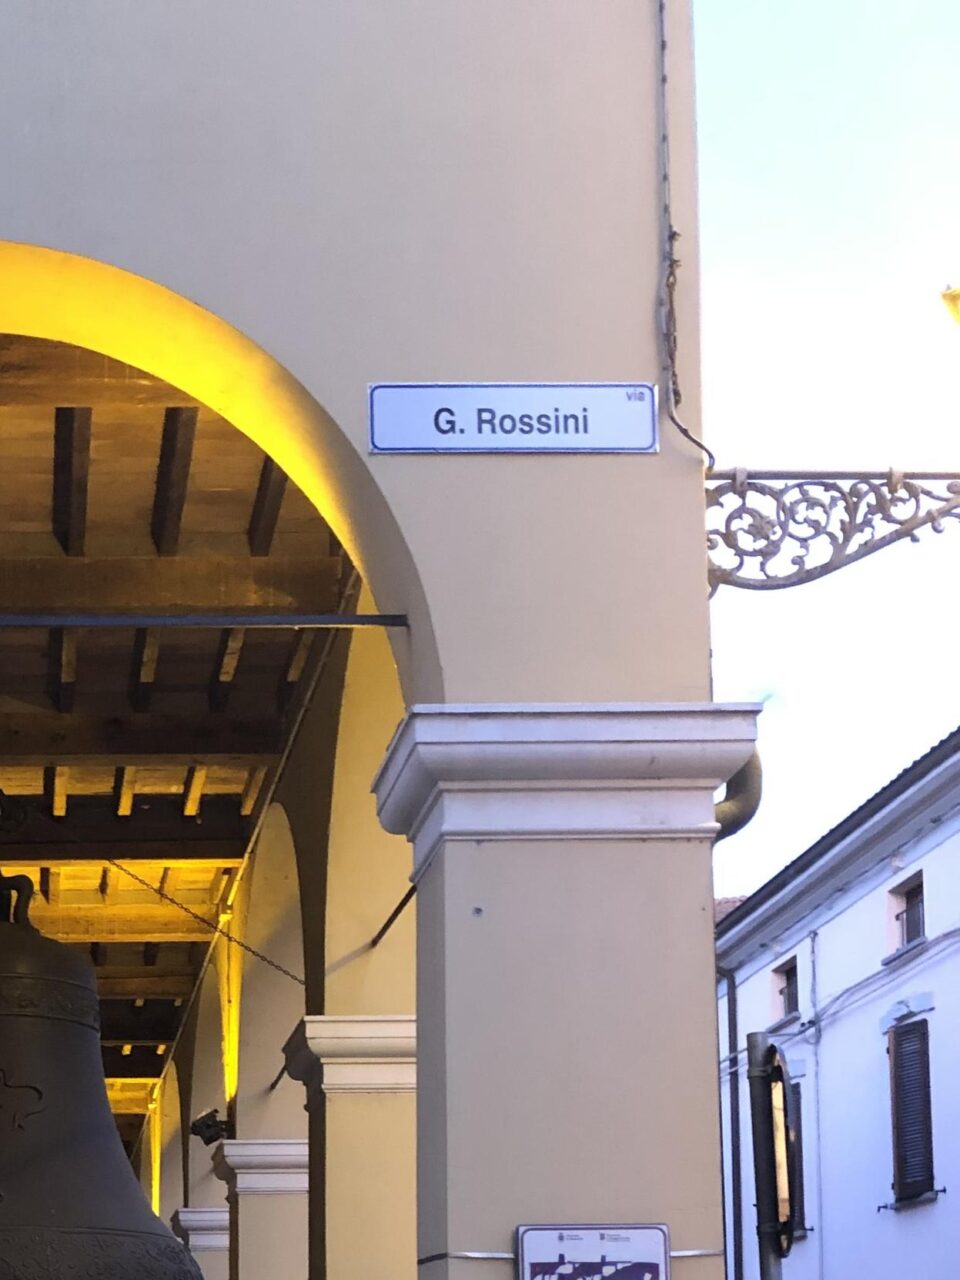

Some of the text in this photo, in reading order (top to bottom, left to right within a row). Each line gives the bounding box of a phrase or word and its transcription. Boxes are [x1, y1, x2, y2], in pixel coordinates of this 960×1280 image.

[626, 389, 646, 402] via
[433, 407, 589, 435] G. Rossini
